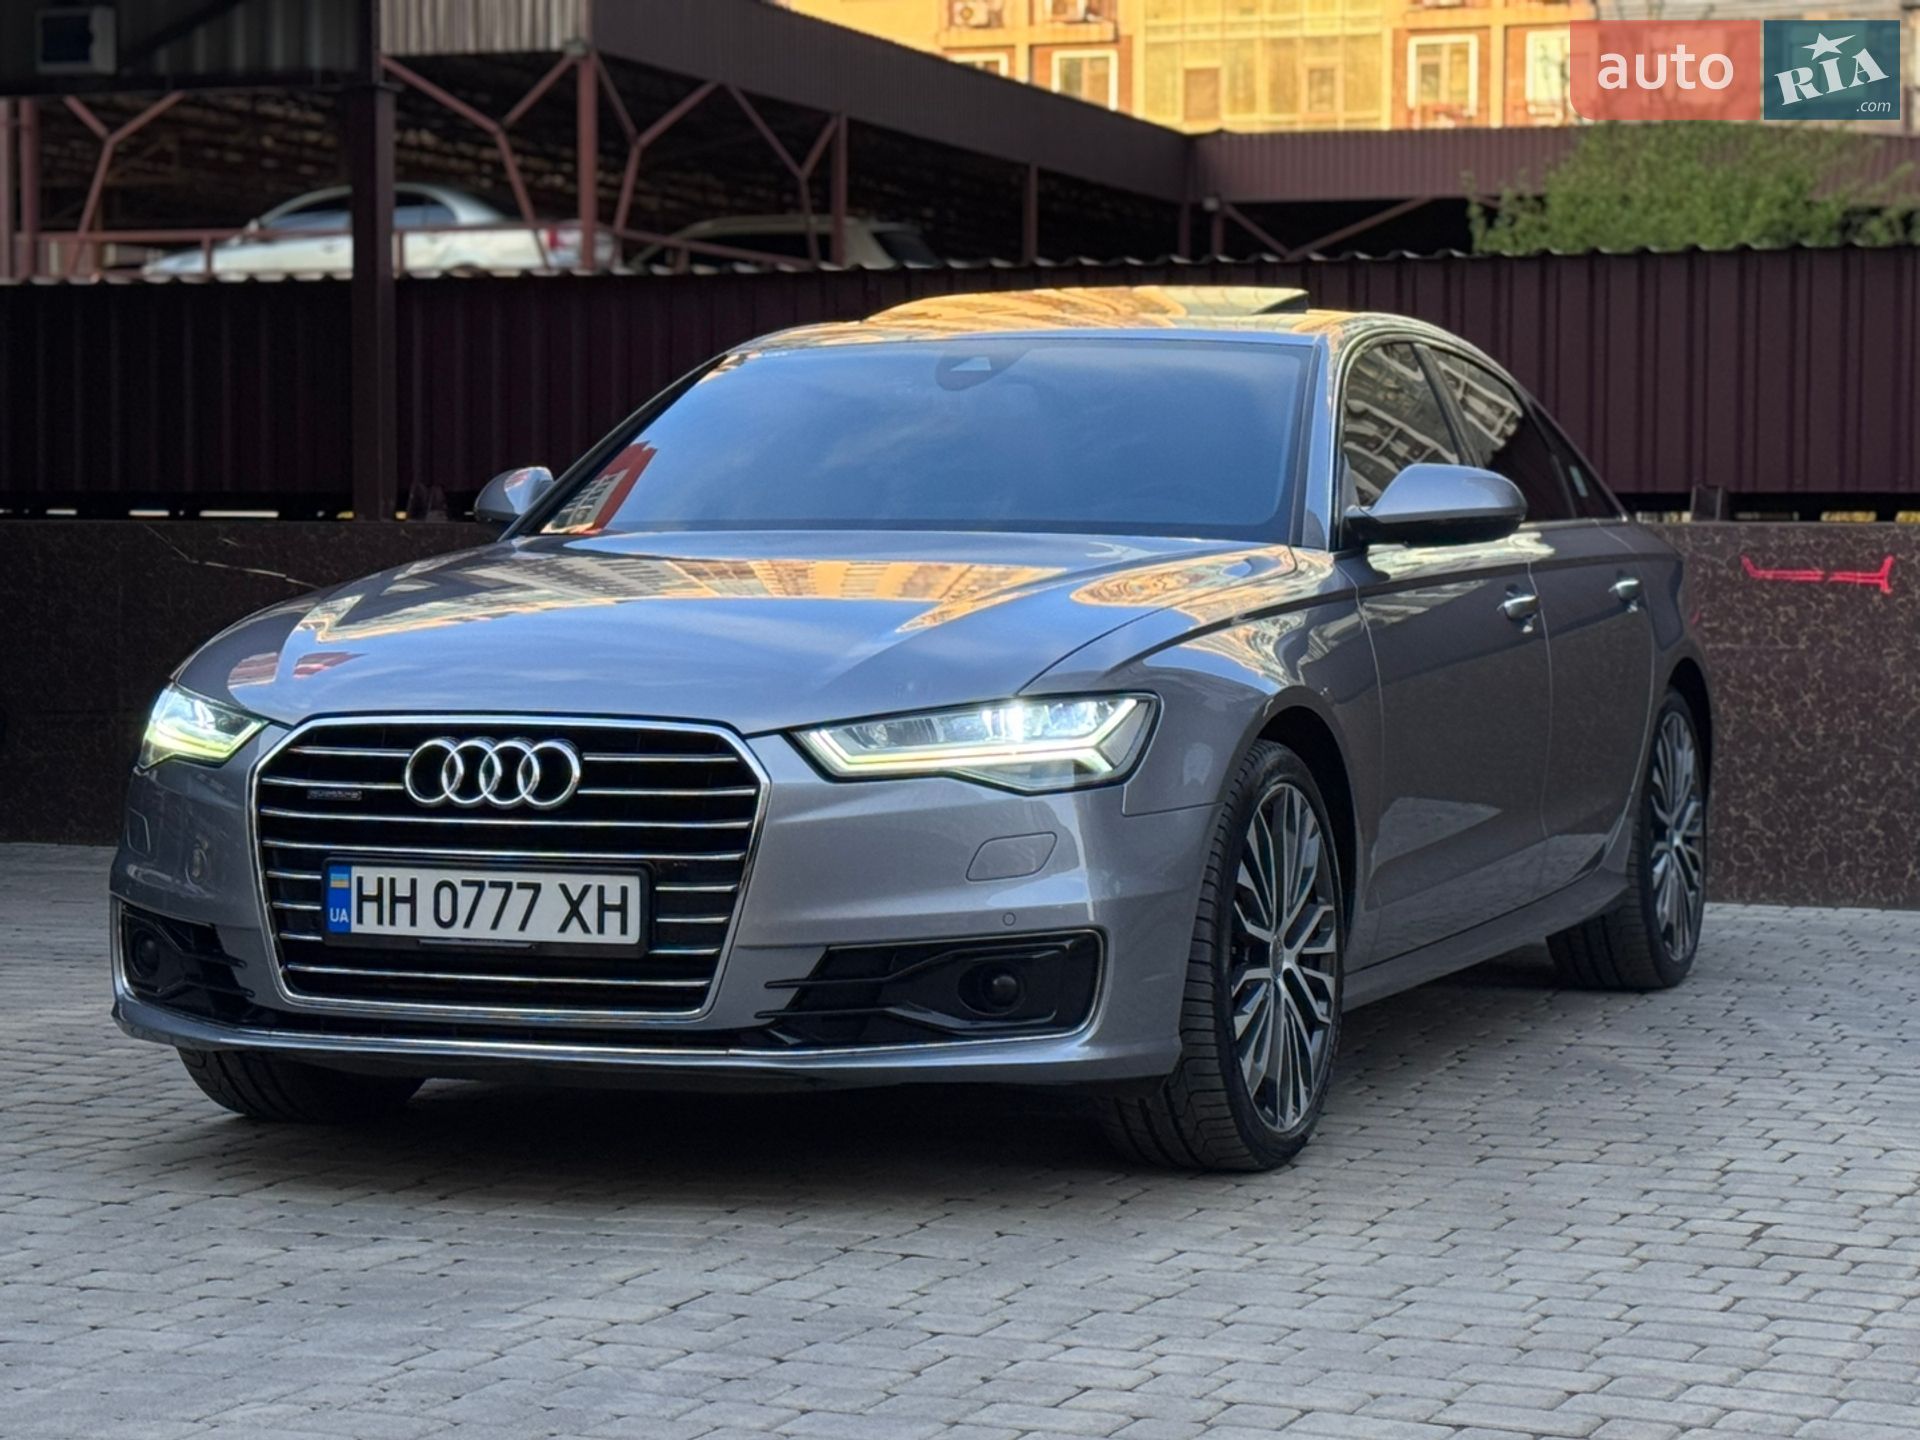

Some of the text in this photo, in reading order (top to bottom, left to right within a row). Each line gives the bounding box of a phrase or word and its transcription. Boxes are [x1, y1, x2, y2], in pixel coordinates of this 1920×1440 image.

[330, 907, 349, 923] UA
[356, 876, 629, 936] HH 0777 XH
